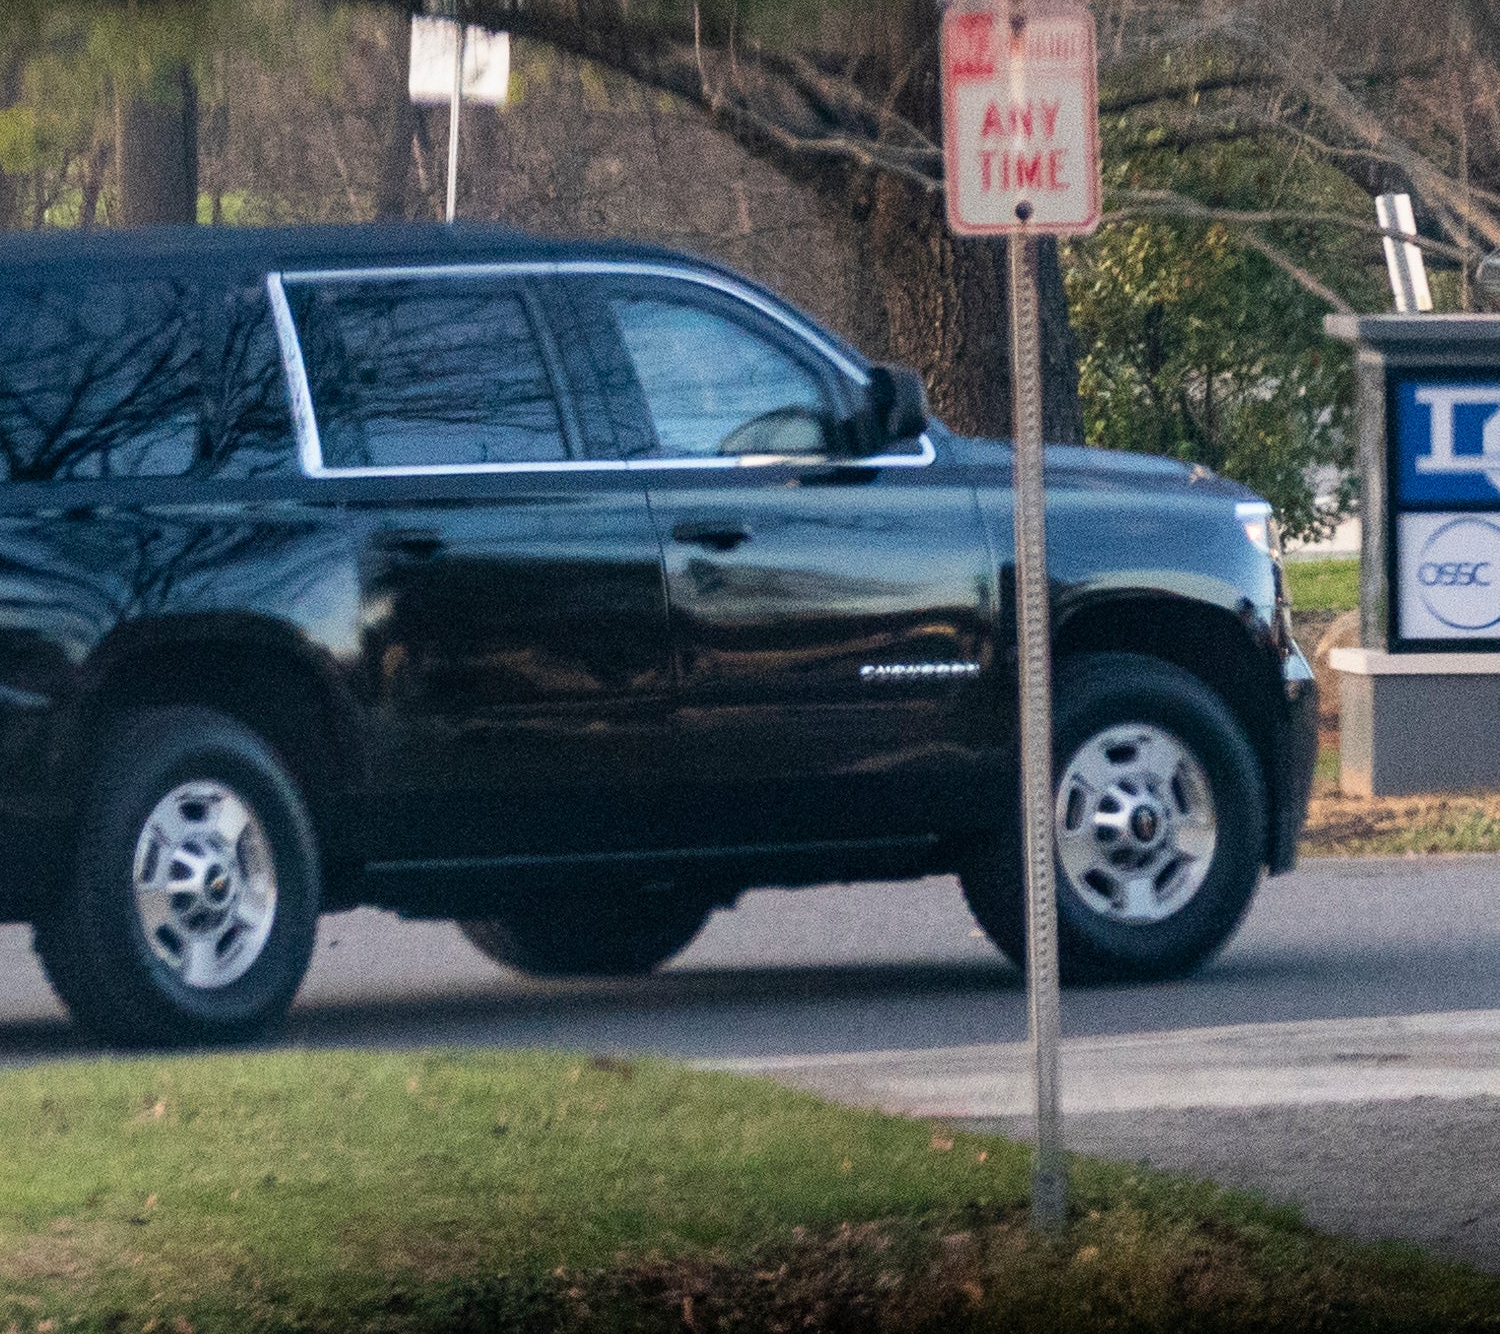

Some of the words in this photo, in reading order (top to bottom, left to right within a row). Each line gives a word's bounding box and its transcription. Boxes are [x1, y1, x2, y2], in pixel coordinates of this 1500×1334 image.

[980, 99, 1061, 139] ANY
[979, 148, 1070, 191] TIME
[1417, 562, 1491, 586] OSSC
